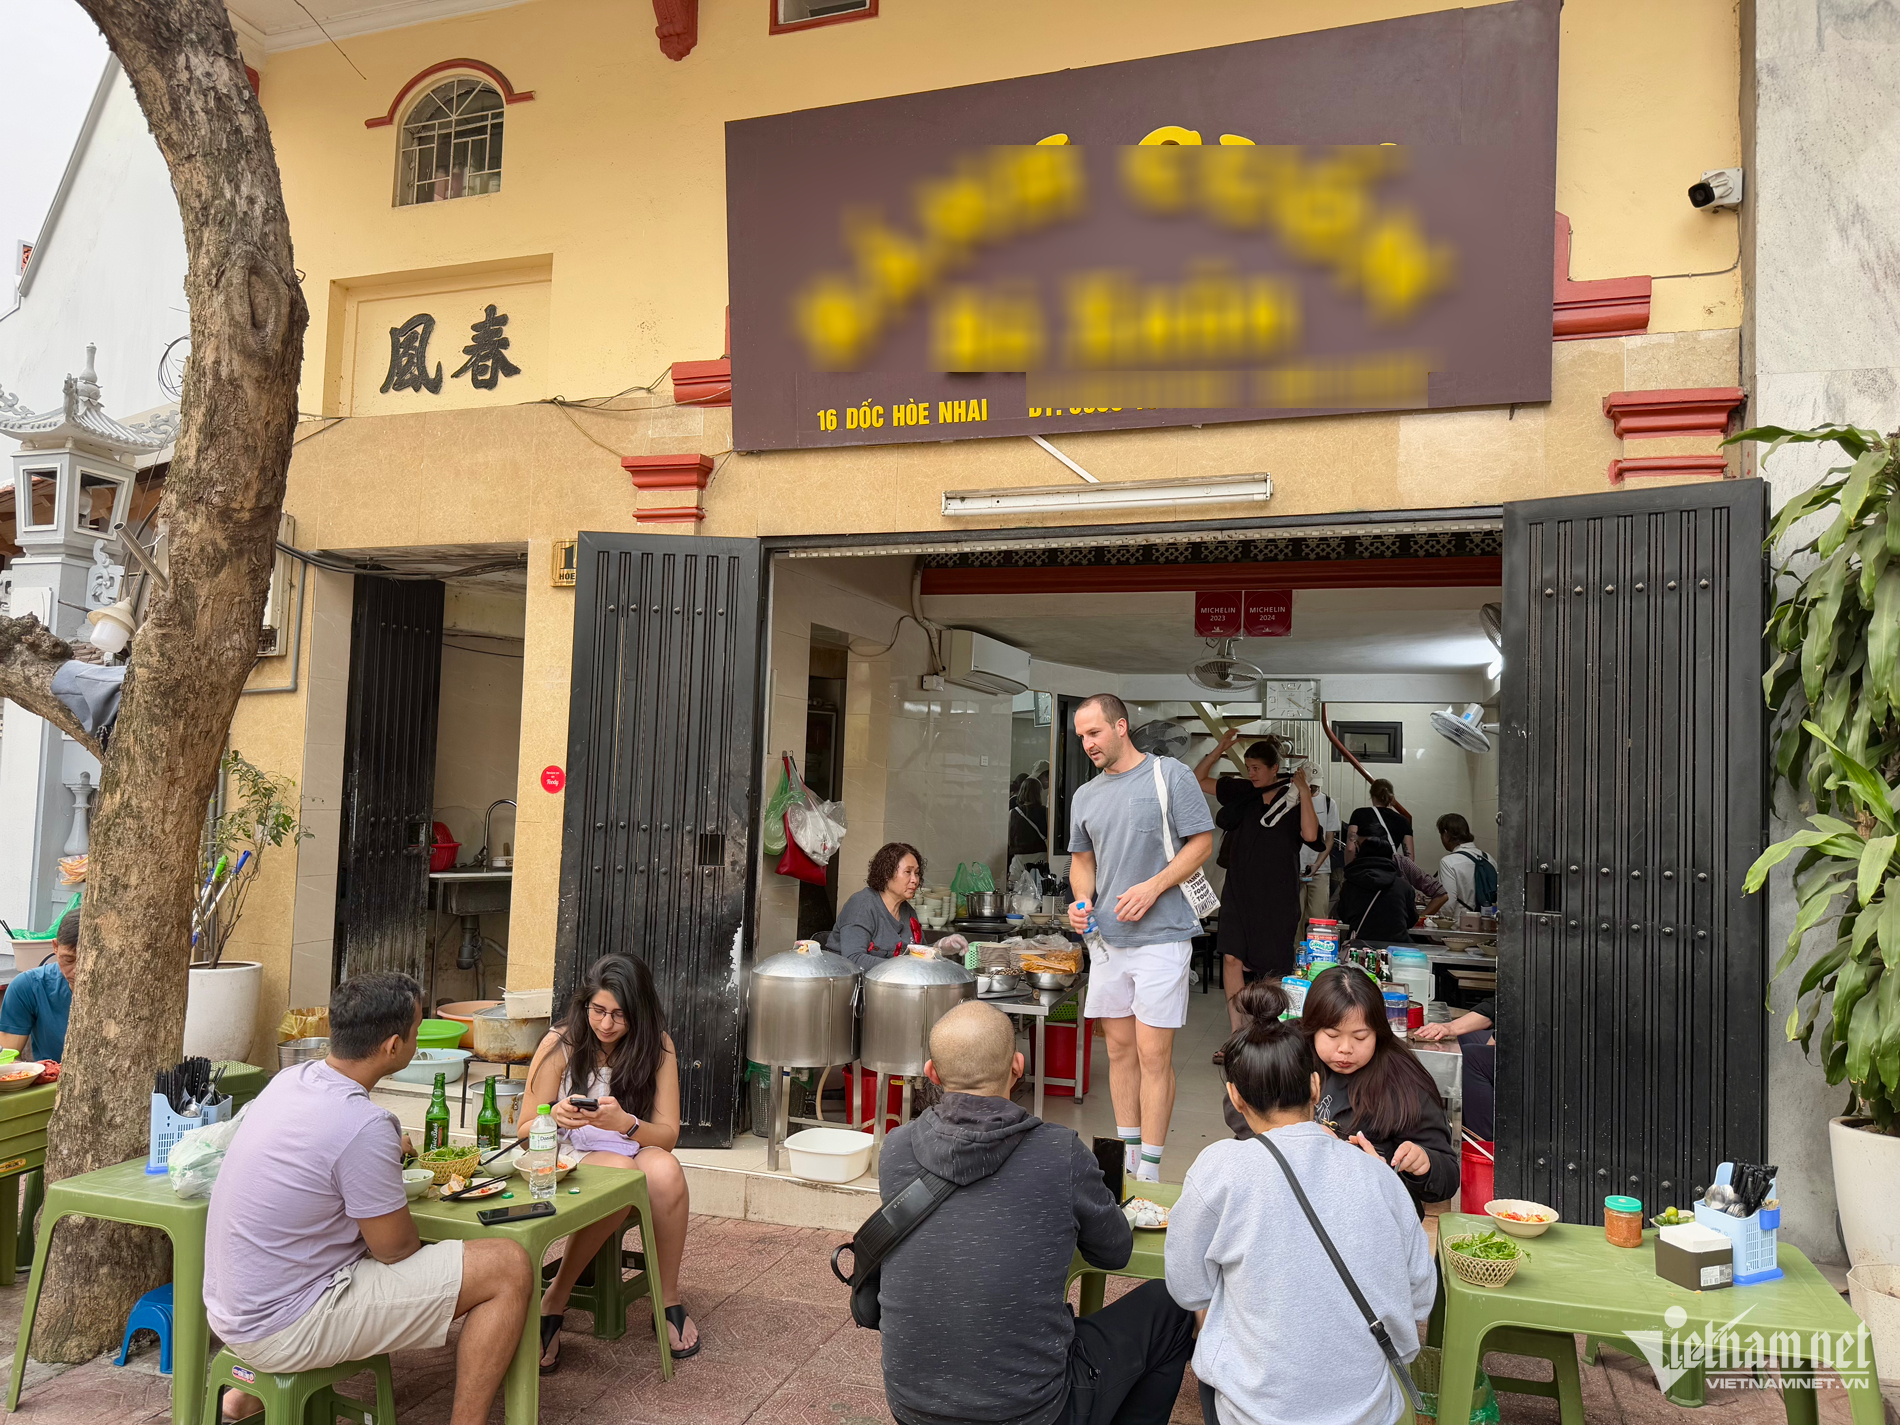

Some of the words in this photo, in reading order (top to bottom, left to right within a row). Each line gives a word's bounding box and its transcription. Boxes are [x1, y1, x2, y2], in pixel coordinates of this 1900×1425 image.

[816, 409, 838, 431] 16
[846, 398, 884, 430] DỐC
[893, 398, 930, 427] HÒE
[938, 399, 988, 424] NHAI
[560, 545, 574, 570] 1
[1194, 883, 1207, 896] FOOD
